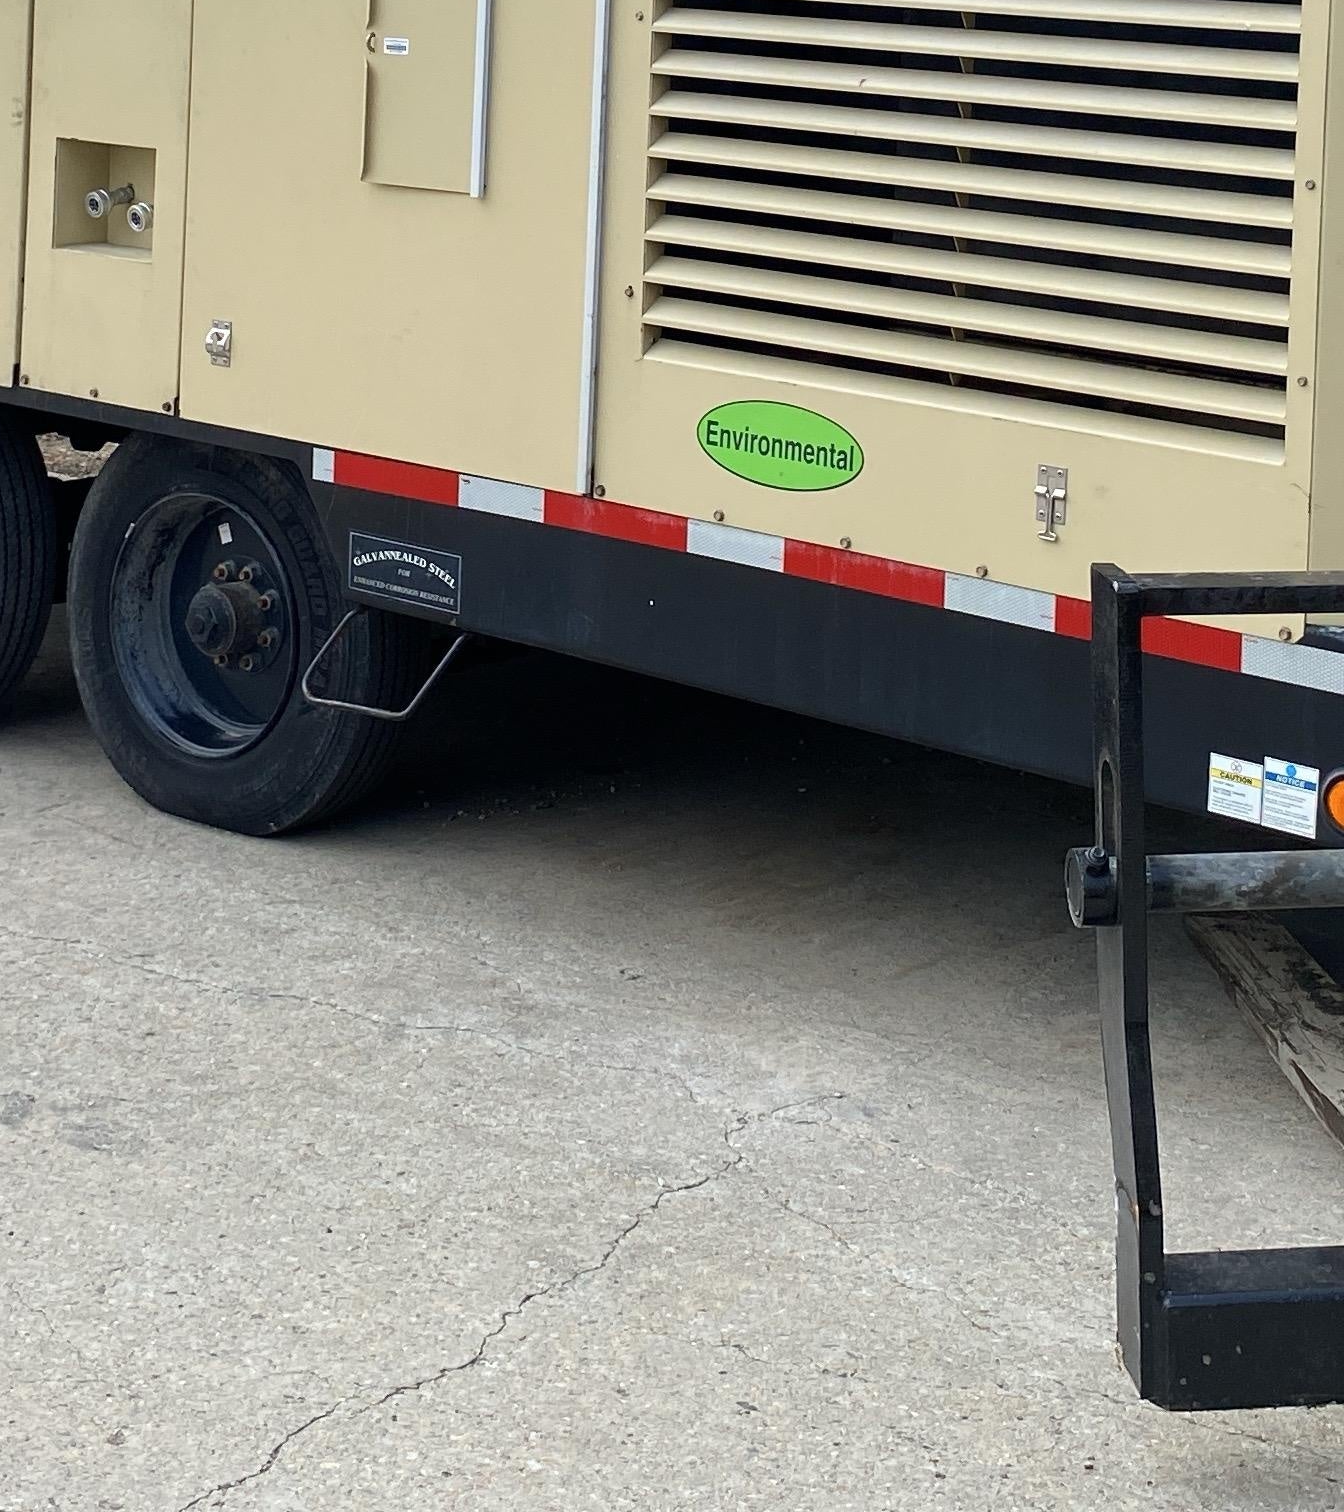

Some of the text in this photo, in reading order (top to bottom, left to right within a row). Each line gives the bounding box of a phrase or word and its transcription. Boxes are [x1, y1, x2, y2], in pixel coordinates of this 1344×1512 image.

[706, 419, 854, 472] Environmental
[353, 550, 456, 590] GALVANNEALED STEEL
[1219, 770, 1254, 786] CAUTION
[1275, 774, 1307, 790] NOTICE
